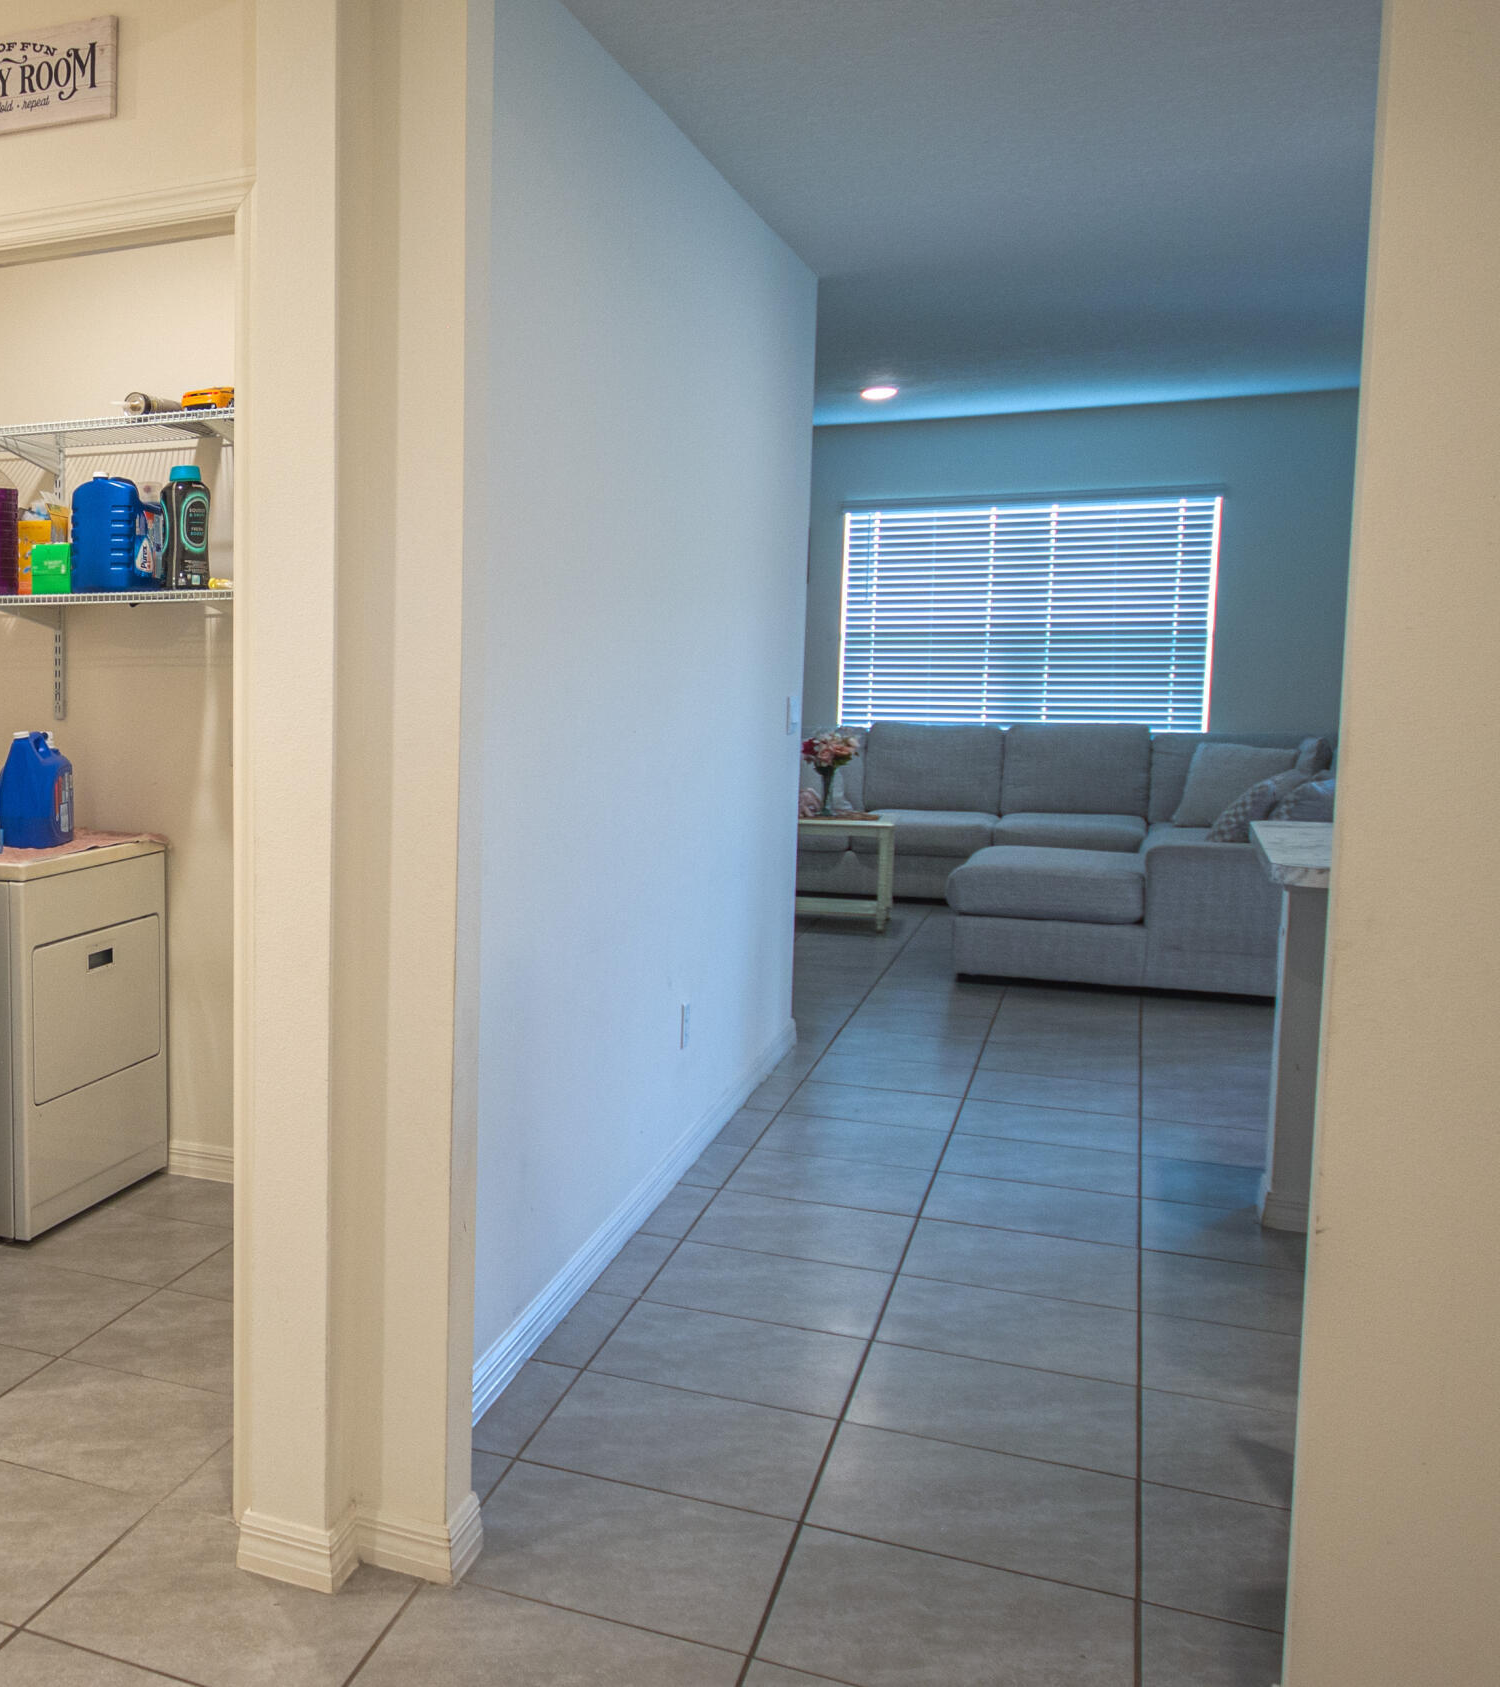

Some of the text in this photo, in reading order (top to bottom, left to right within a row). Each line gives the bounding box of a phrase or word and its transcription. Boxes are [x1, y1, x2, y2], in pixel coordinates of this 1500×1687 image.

[20, 42, 58, 56] FUN
[19, 41, 98, 101] ROOM
[21, 95, 50, 111] repeat
[140, 545, 148, 570] Purex
